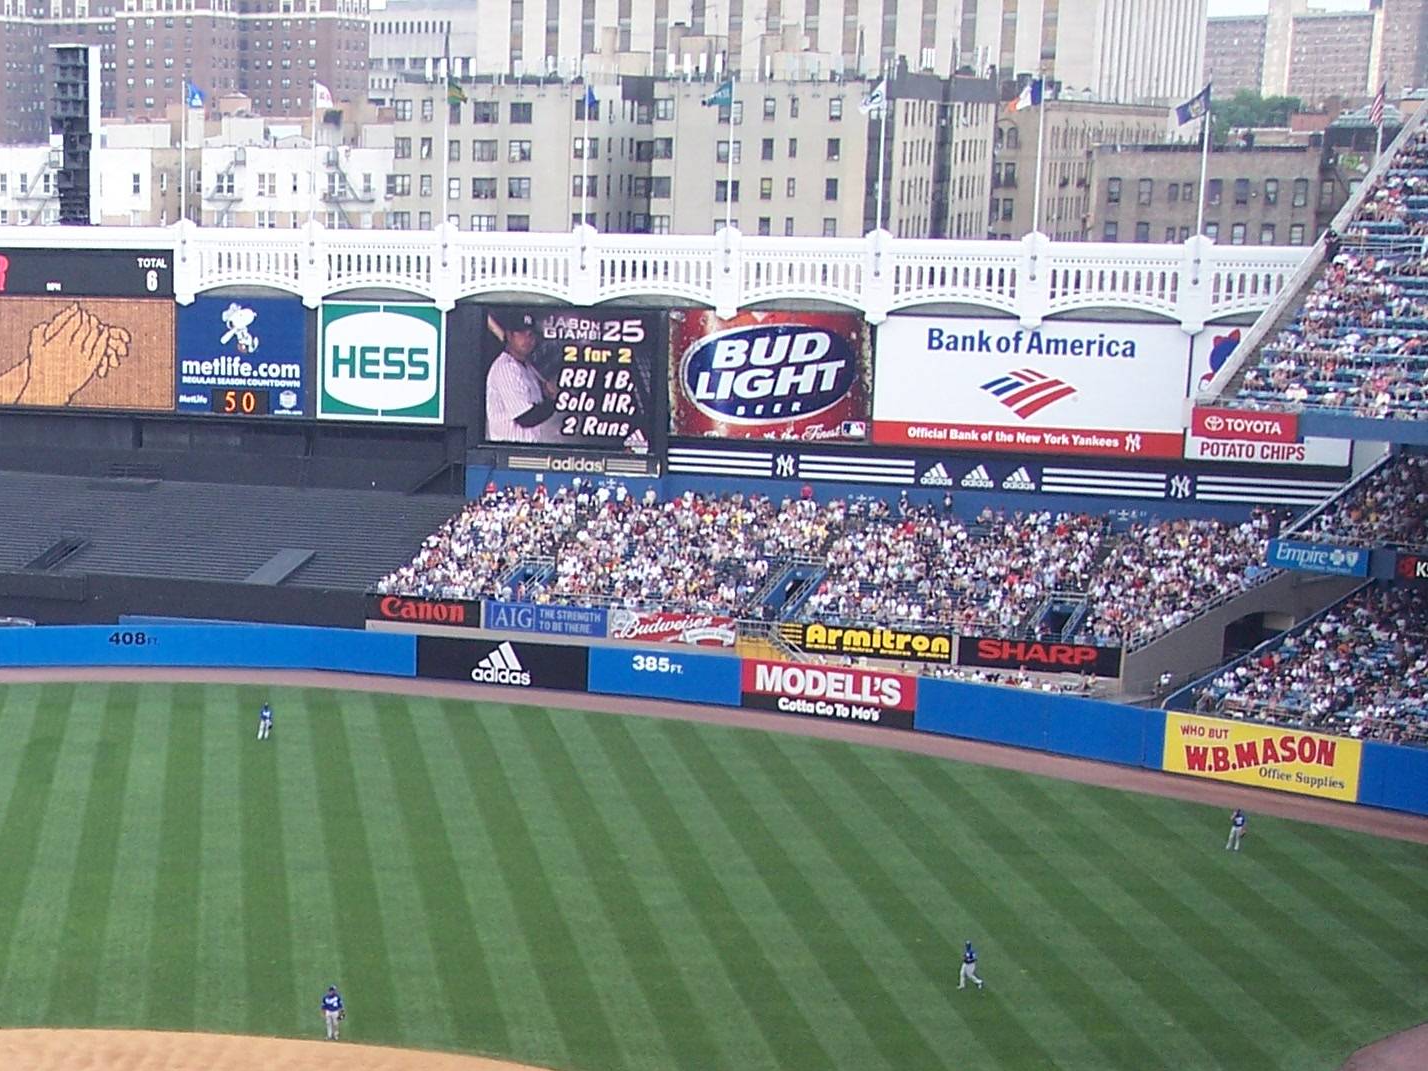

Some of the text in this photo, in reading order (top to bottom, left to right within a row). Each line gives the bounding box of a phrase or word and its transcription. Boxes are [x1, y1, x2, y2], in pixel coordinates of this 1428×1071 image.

[137, 257, 167, 269] TOTAL
[146, 269, 158, 291] 6
[543, 315, 601, 330] JASON
[543, 319, 645, 343] GIAMBI 25
[712, 331, 831, 369] BUD
[927, 328, 1136, 358] Bank of America
[332, 345, 430, 381] HESS
[563, 346, 632, 364] 2 for 2
[182, 355, 301, 378] metlife.com
[181, 376, 217, 385] REGULAR
[559, 368, 634, 392] RBI 1B,
[695, 360, 846, 401] LIGHT
[556, 391, 636, 416] Solo HR,
[736, 402, 802, 416] BEER
[562, 416, 630, 437] 2 Runs
[907, 426, 1120, 448] Official Bank of the New York Yankees
[1225, 418, 1282, 435] TOYOTA
[1200, 441, 1306, 461] POTATO CHIPS
[551, 457, 603, 472] adidas
[1275, 541, 1329, 568] Empire
[380, 596, 465, 623] Canon
[494, 605, 533, 628] AIG
[539, 608, 601, 623] THE STRENGTH
[539, 620, 550, 631] TO
[551, 621, 564, 632] BE
[614, 612, 713, 639] Budweiser
[108, 631, 146, 646] 408
[805, 624, 950, 654] Armitron
[976, 639, 1098, 665] SHARP
[632, 656, 670, 673] 385
[472, 666, 532, 686] adidas
[754, 664, 902, 706] MODELL'S
[778, 697, 880, 722] Gotta Go To Mo's
[1180, 724, 1229, 740] WHO BUT
[1258, 766, 1345, 789] Office Supplies
